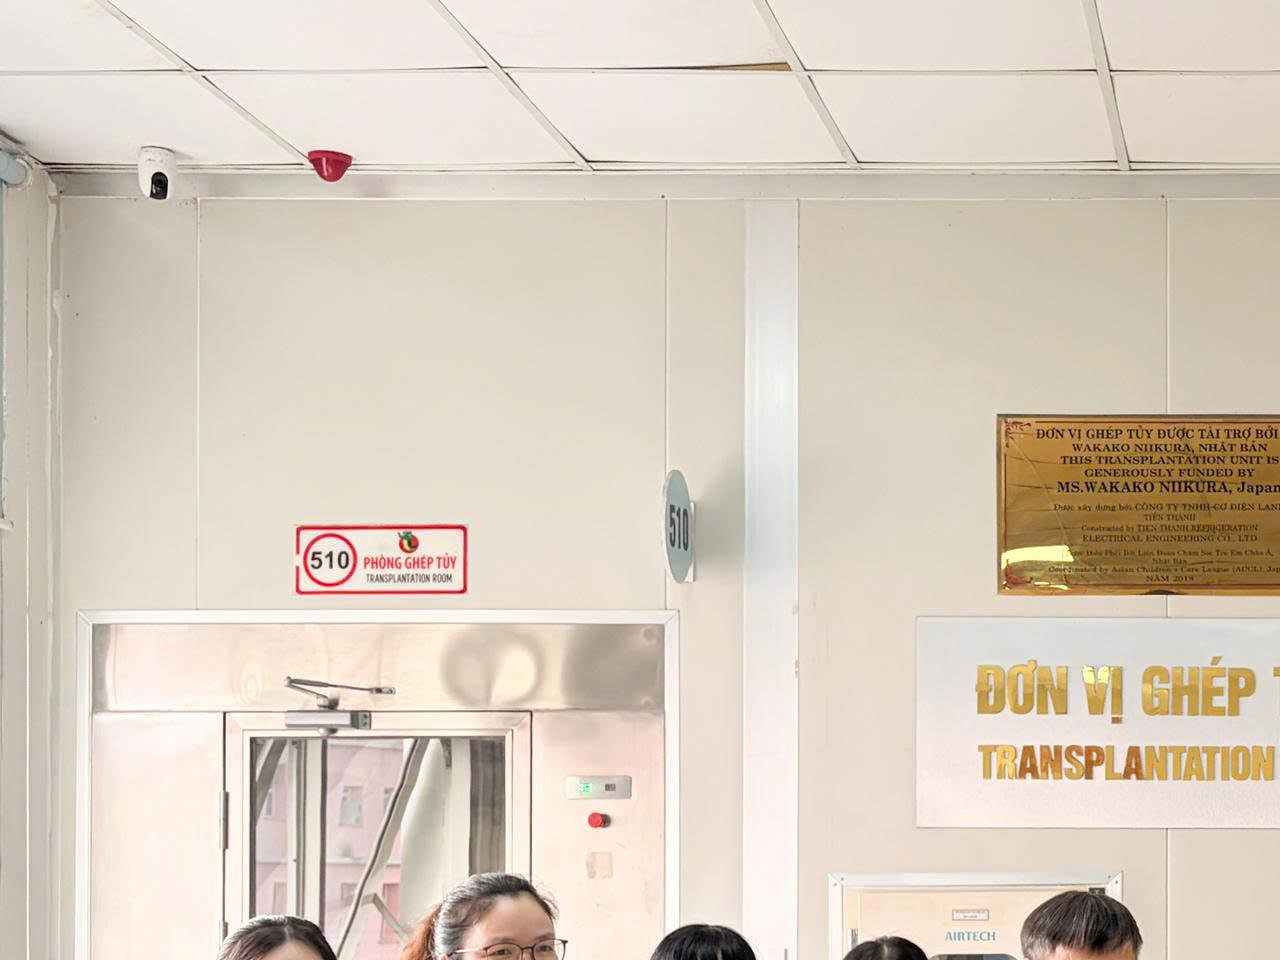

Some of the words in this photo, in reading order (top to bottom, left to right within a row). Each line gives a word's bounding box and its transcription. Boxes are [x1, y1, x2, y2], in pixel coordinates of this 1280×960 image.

[1036, 427, 1064, 439] ĐƠN
[1068, 428, 1081, 441] VỊ
[1086, 426, 1123, 439] GHÉP
[1157, 427, 1194, 441] ĐƯỢC
[1198, 425, 1219, 439] TÀI
[1224, 427, 1251, 440] TRỢ
[1255, 425, 1278, 439] BỞI
[1072, 443, 1130, 452] WAKAKO
[1134, 443, 1195, 454] NIIKURA,
[1060, 456, 1092, 464] THIS
[1096, 456, 1225, 465] TRANSPLANTATION
[1230, 456, 1263, 465] UNIT
[1266, 456, 1280, 465] IS
[1084, 468, 1174, 478] GENEROUSLY
[1179, 468, 1233, 477] FUNDED
[1238, 469, 1255, 477] BY
[1159, 481, 1232, 495] NIIKURA,
[1135, 502, 1163, 511] CÔNG
[1167, 503, 1179, 511] TY
[669, 503, 689, 552] 510
[1082, 535, 1143, 543] ELECTRICAL
[1146, 535, 1214, 543] ENGINEERING
[310, 550, 349, 569] 510
[363, 553, 401, 569] PHÒNG
[404, 553, 433, 569] GHÉP
[436, 552, 457, 569] TỦY
[366, 573, 431, 583] TRANSPLANTATION
[432, 573, 452, 583] ROOM
[976, 659, 1068, 715] ĐƠN
[1081, 664, 1123, 724] VỊ
[1141, 656, 1256, 717] GHÉP
[978, 744, 1275, 782] TRANSPLANTATION
[945, 931, 996, 941] AIRTECH
